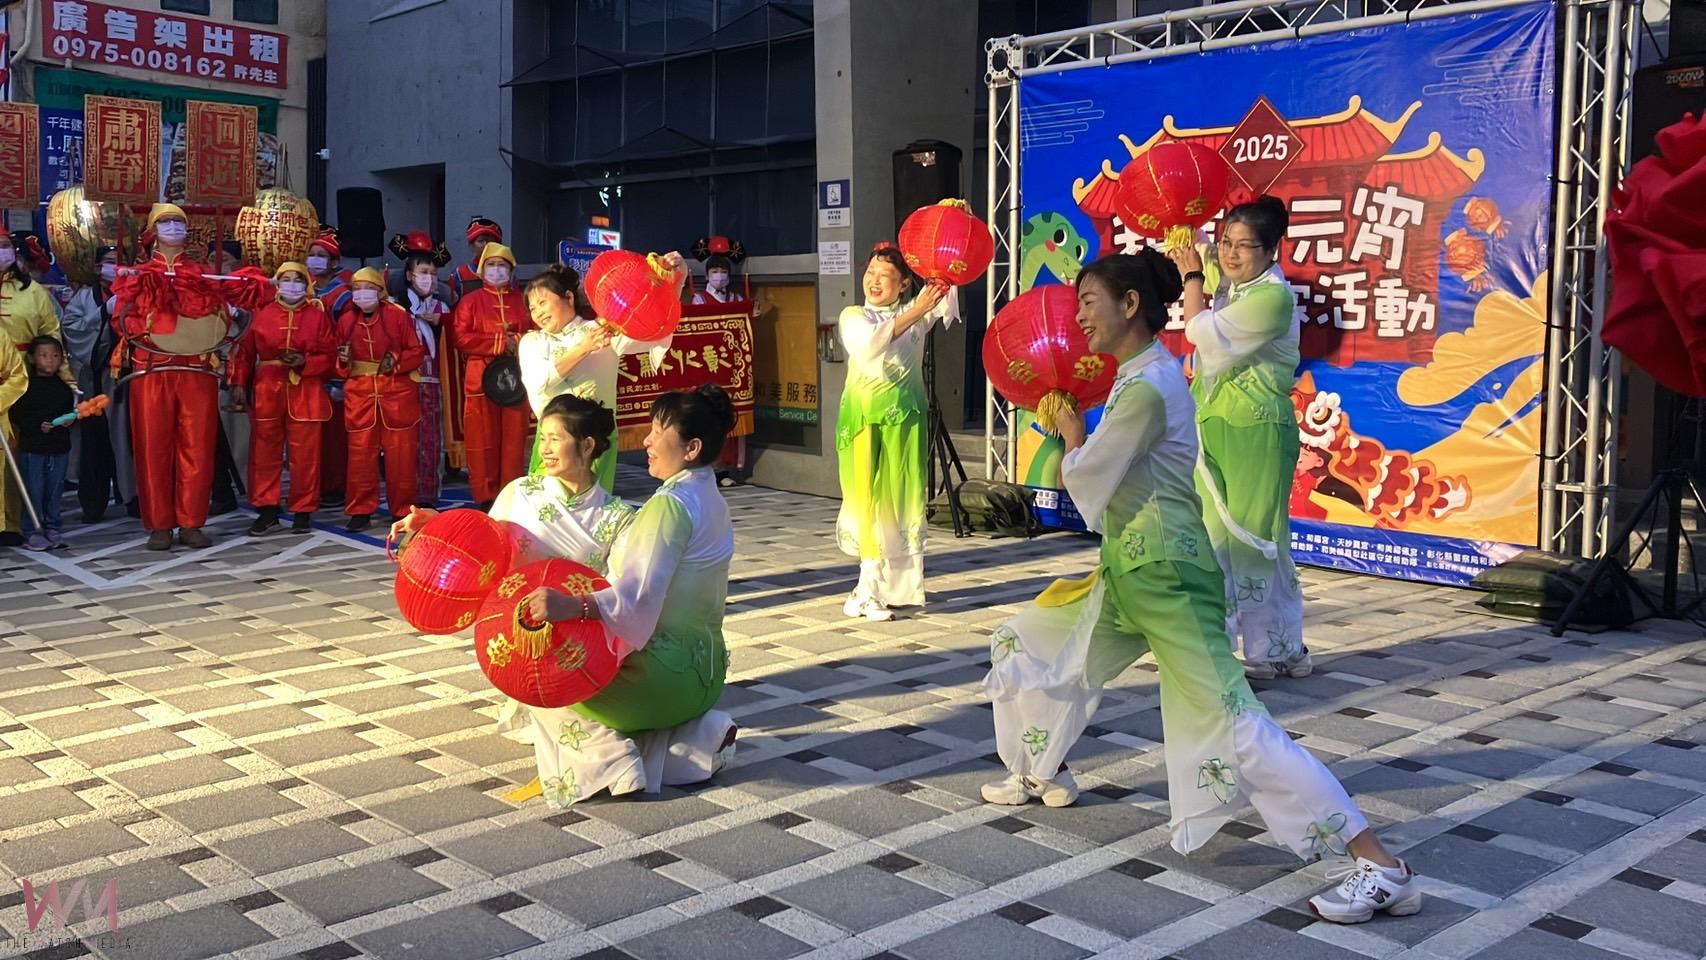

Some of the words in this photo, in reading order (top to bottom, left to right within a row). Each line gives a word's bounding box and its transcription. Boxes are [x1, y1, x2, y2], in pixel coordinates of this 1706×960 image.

[52, 1, 279, 64] 廣告架出租
[53, 36, 226, 78] 0975-008162
[102, 108, 144, 193] 肅靜
[1232, 134, 1289, 163] 2025
[779, 408, 804, 420] Service
